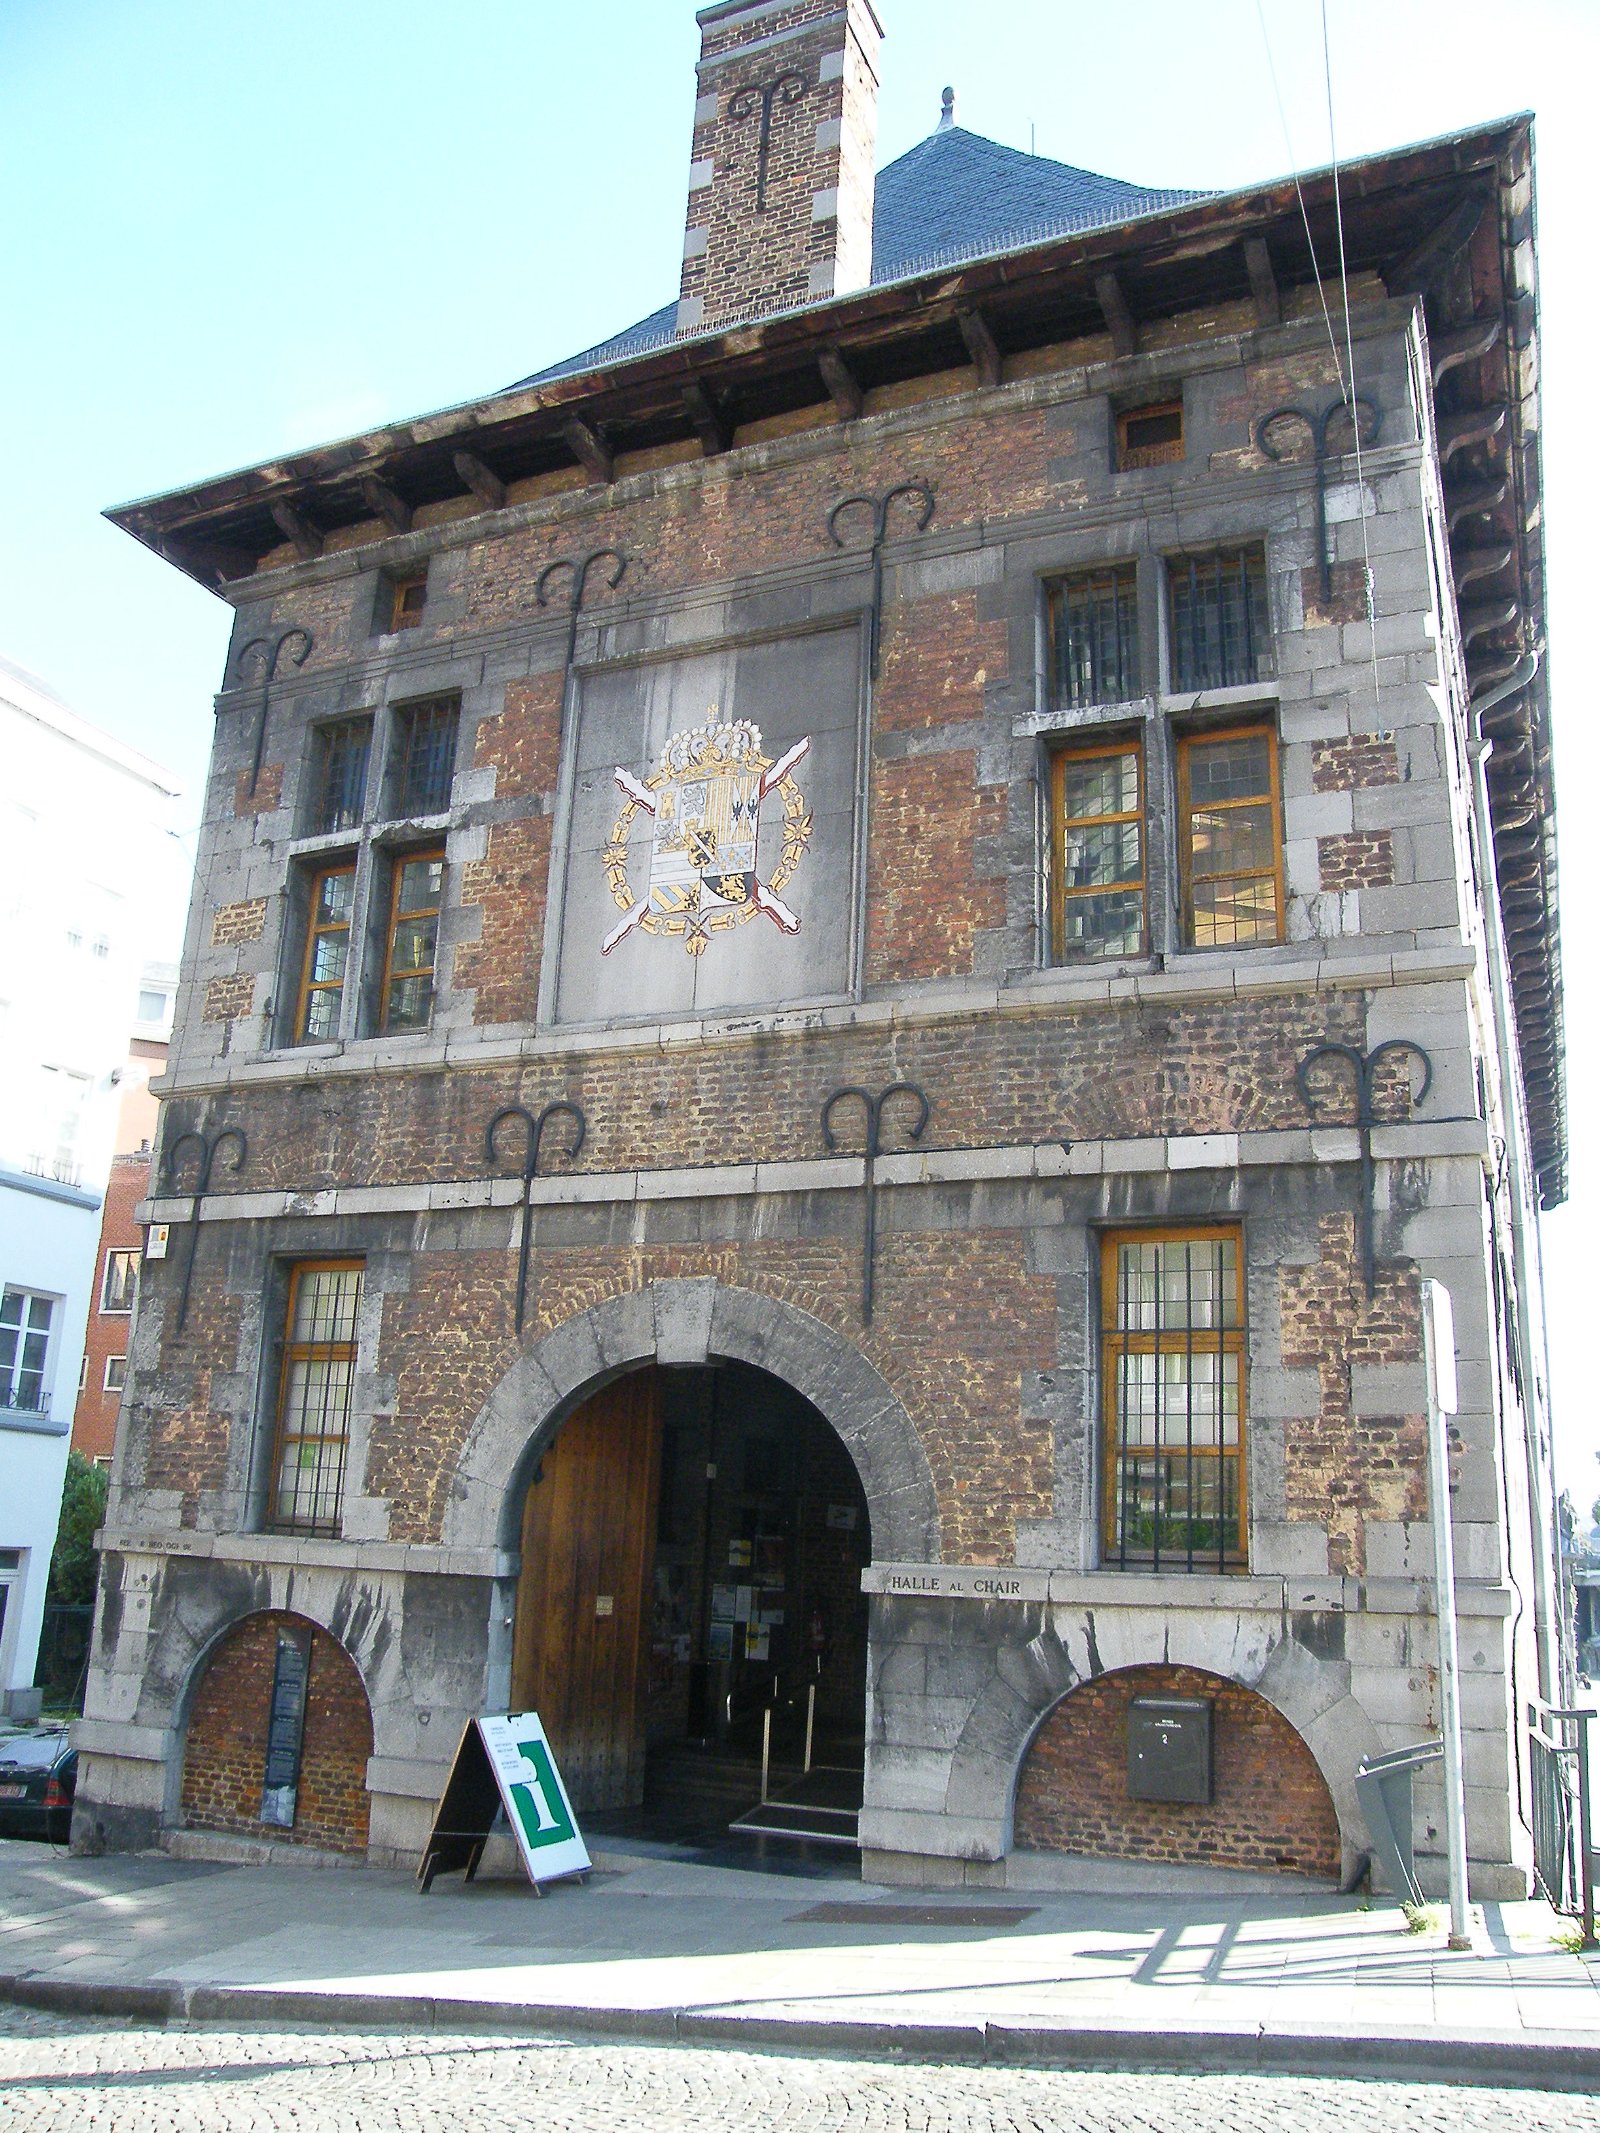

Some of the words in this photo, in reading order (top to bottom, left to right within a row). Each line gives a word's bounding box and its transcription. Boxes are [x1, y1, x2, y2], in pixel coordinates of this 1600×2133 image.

[892, 1576, 940, 1590] HALLE
[949, 1582, 964, 1591] AL
[973, 1579, 1020, 1594] CHAIR
[1161, 1733, 1168, 1745] 2
